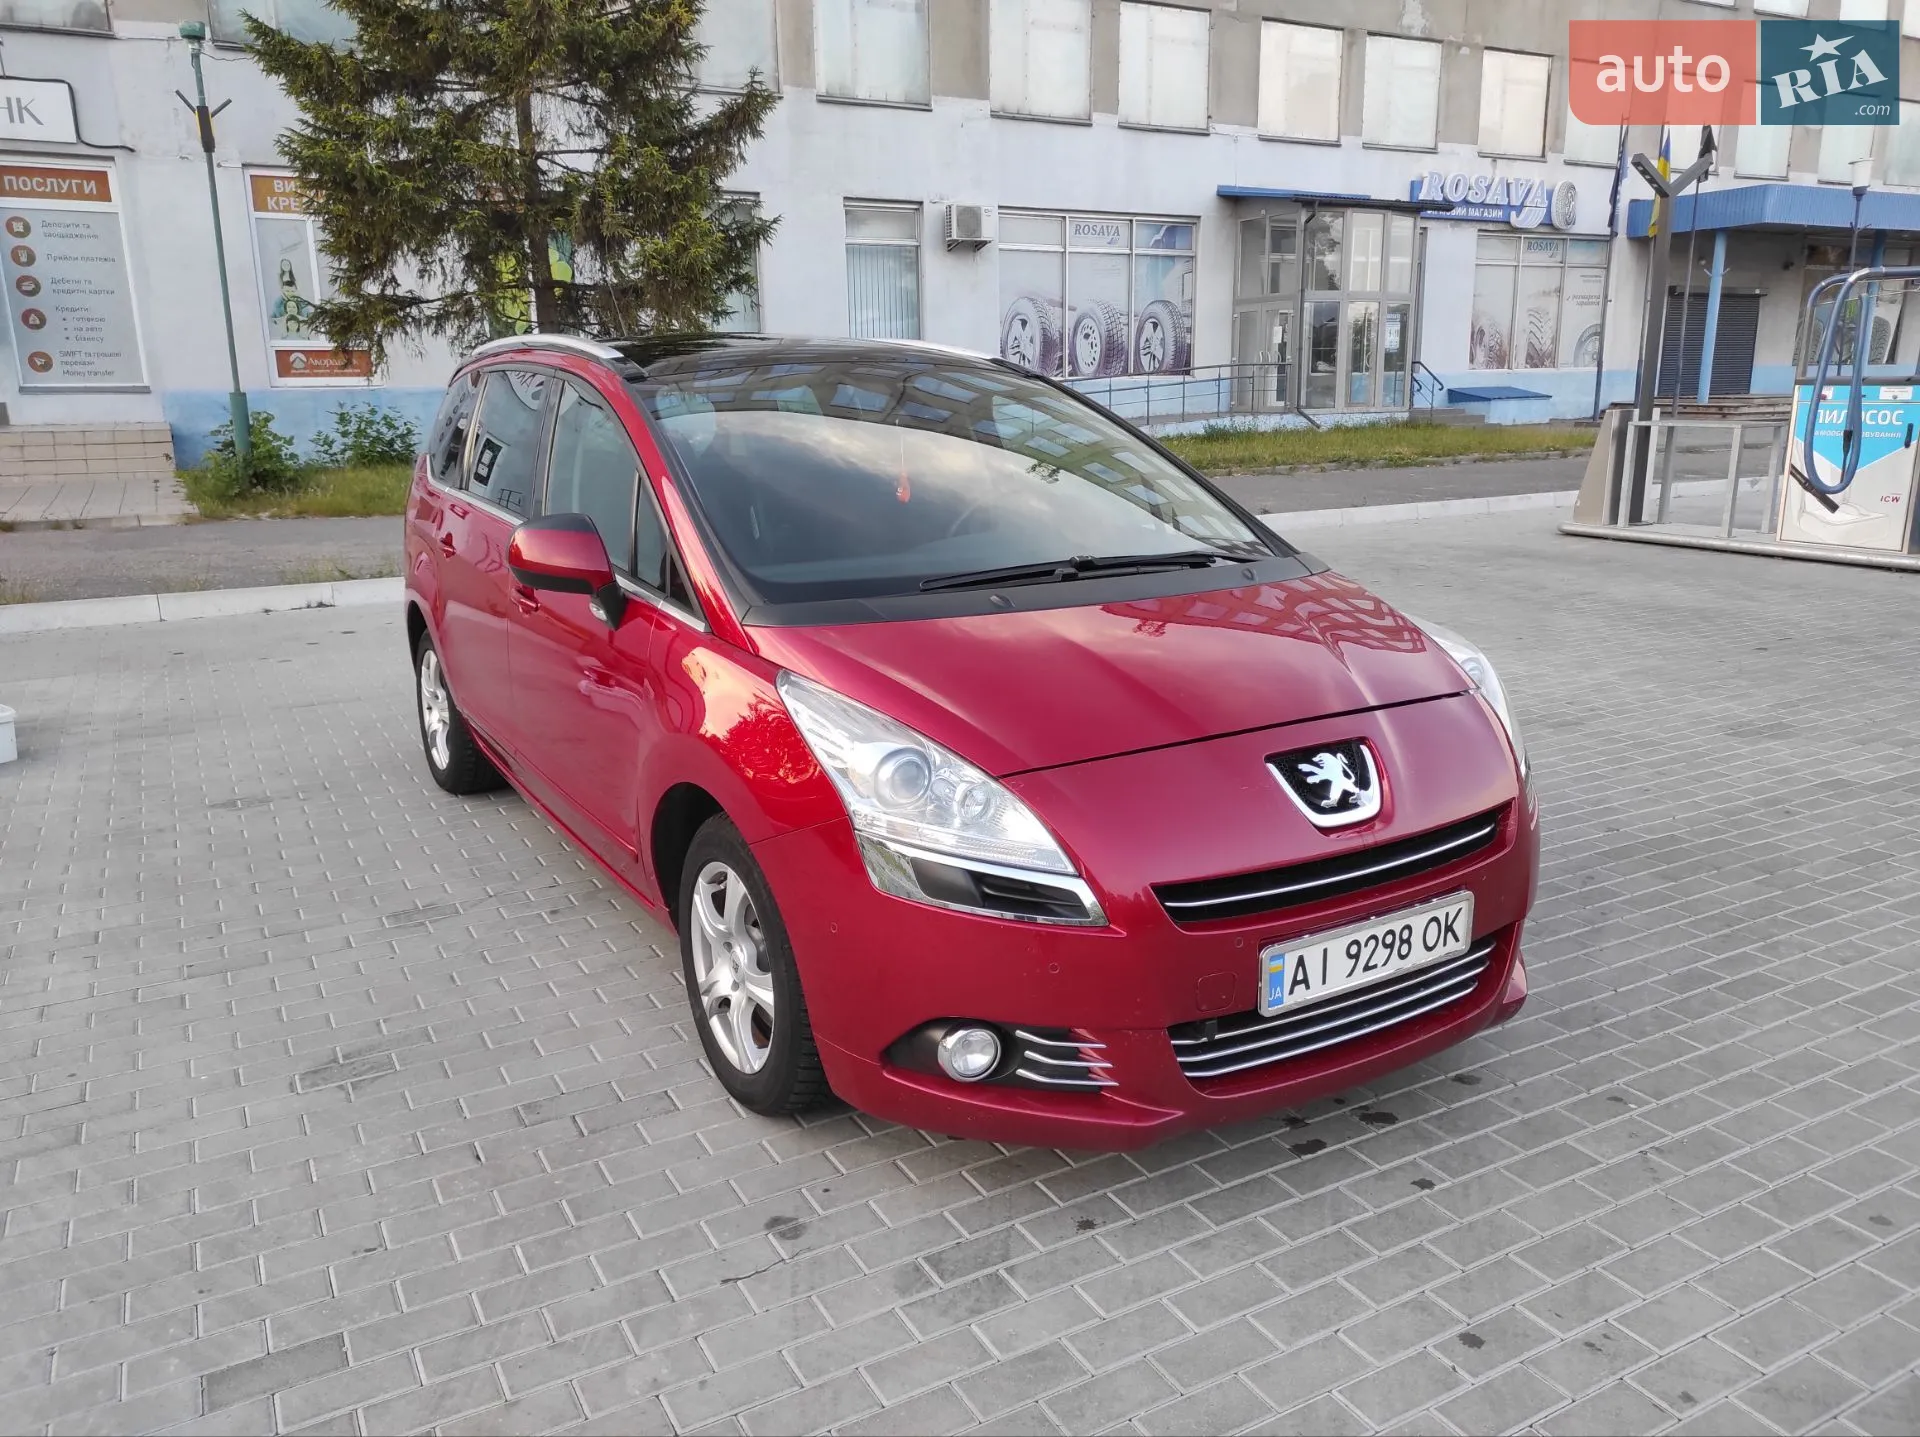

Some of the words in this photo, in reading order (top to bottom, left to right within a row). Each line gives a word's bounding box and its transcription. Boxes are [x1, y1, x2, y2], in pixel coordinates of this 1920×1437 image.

[3, 175, 97, 195] ПОСЛУГИ
[1418, 170, 1548, 208] ROSAVA
[1468, 207, 1503, 218] МАГАЗИН
[1074, 224, 1120, 236] ROSAVA
[1526, 241, 1559, 251] ROSAVA
[59, 350, 83, 358] SWIFT
[1880, 495, 1900, 503] ICW
[1288, 947, 1328, 995] AI
[1345, 924, 1413, 978] 9298
[1422, 907, 1463, 952] OK
